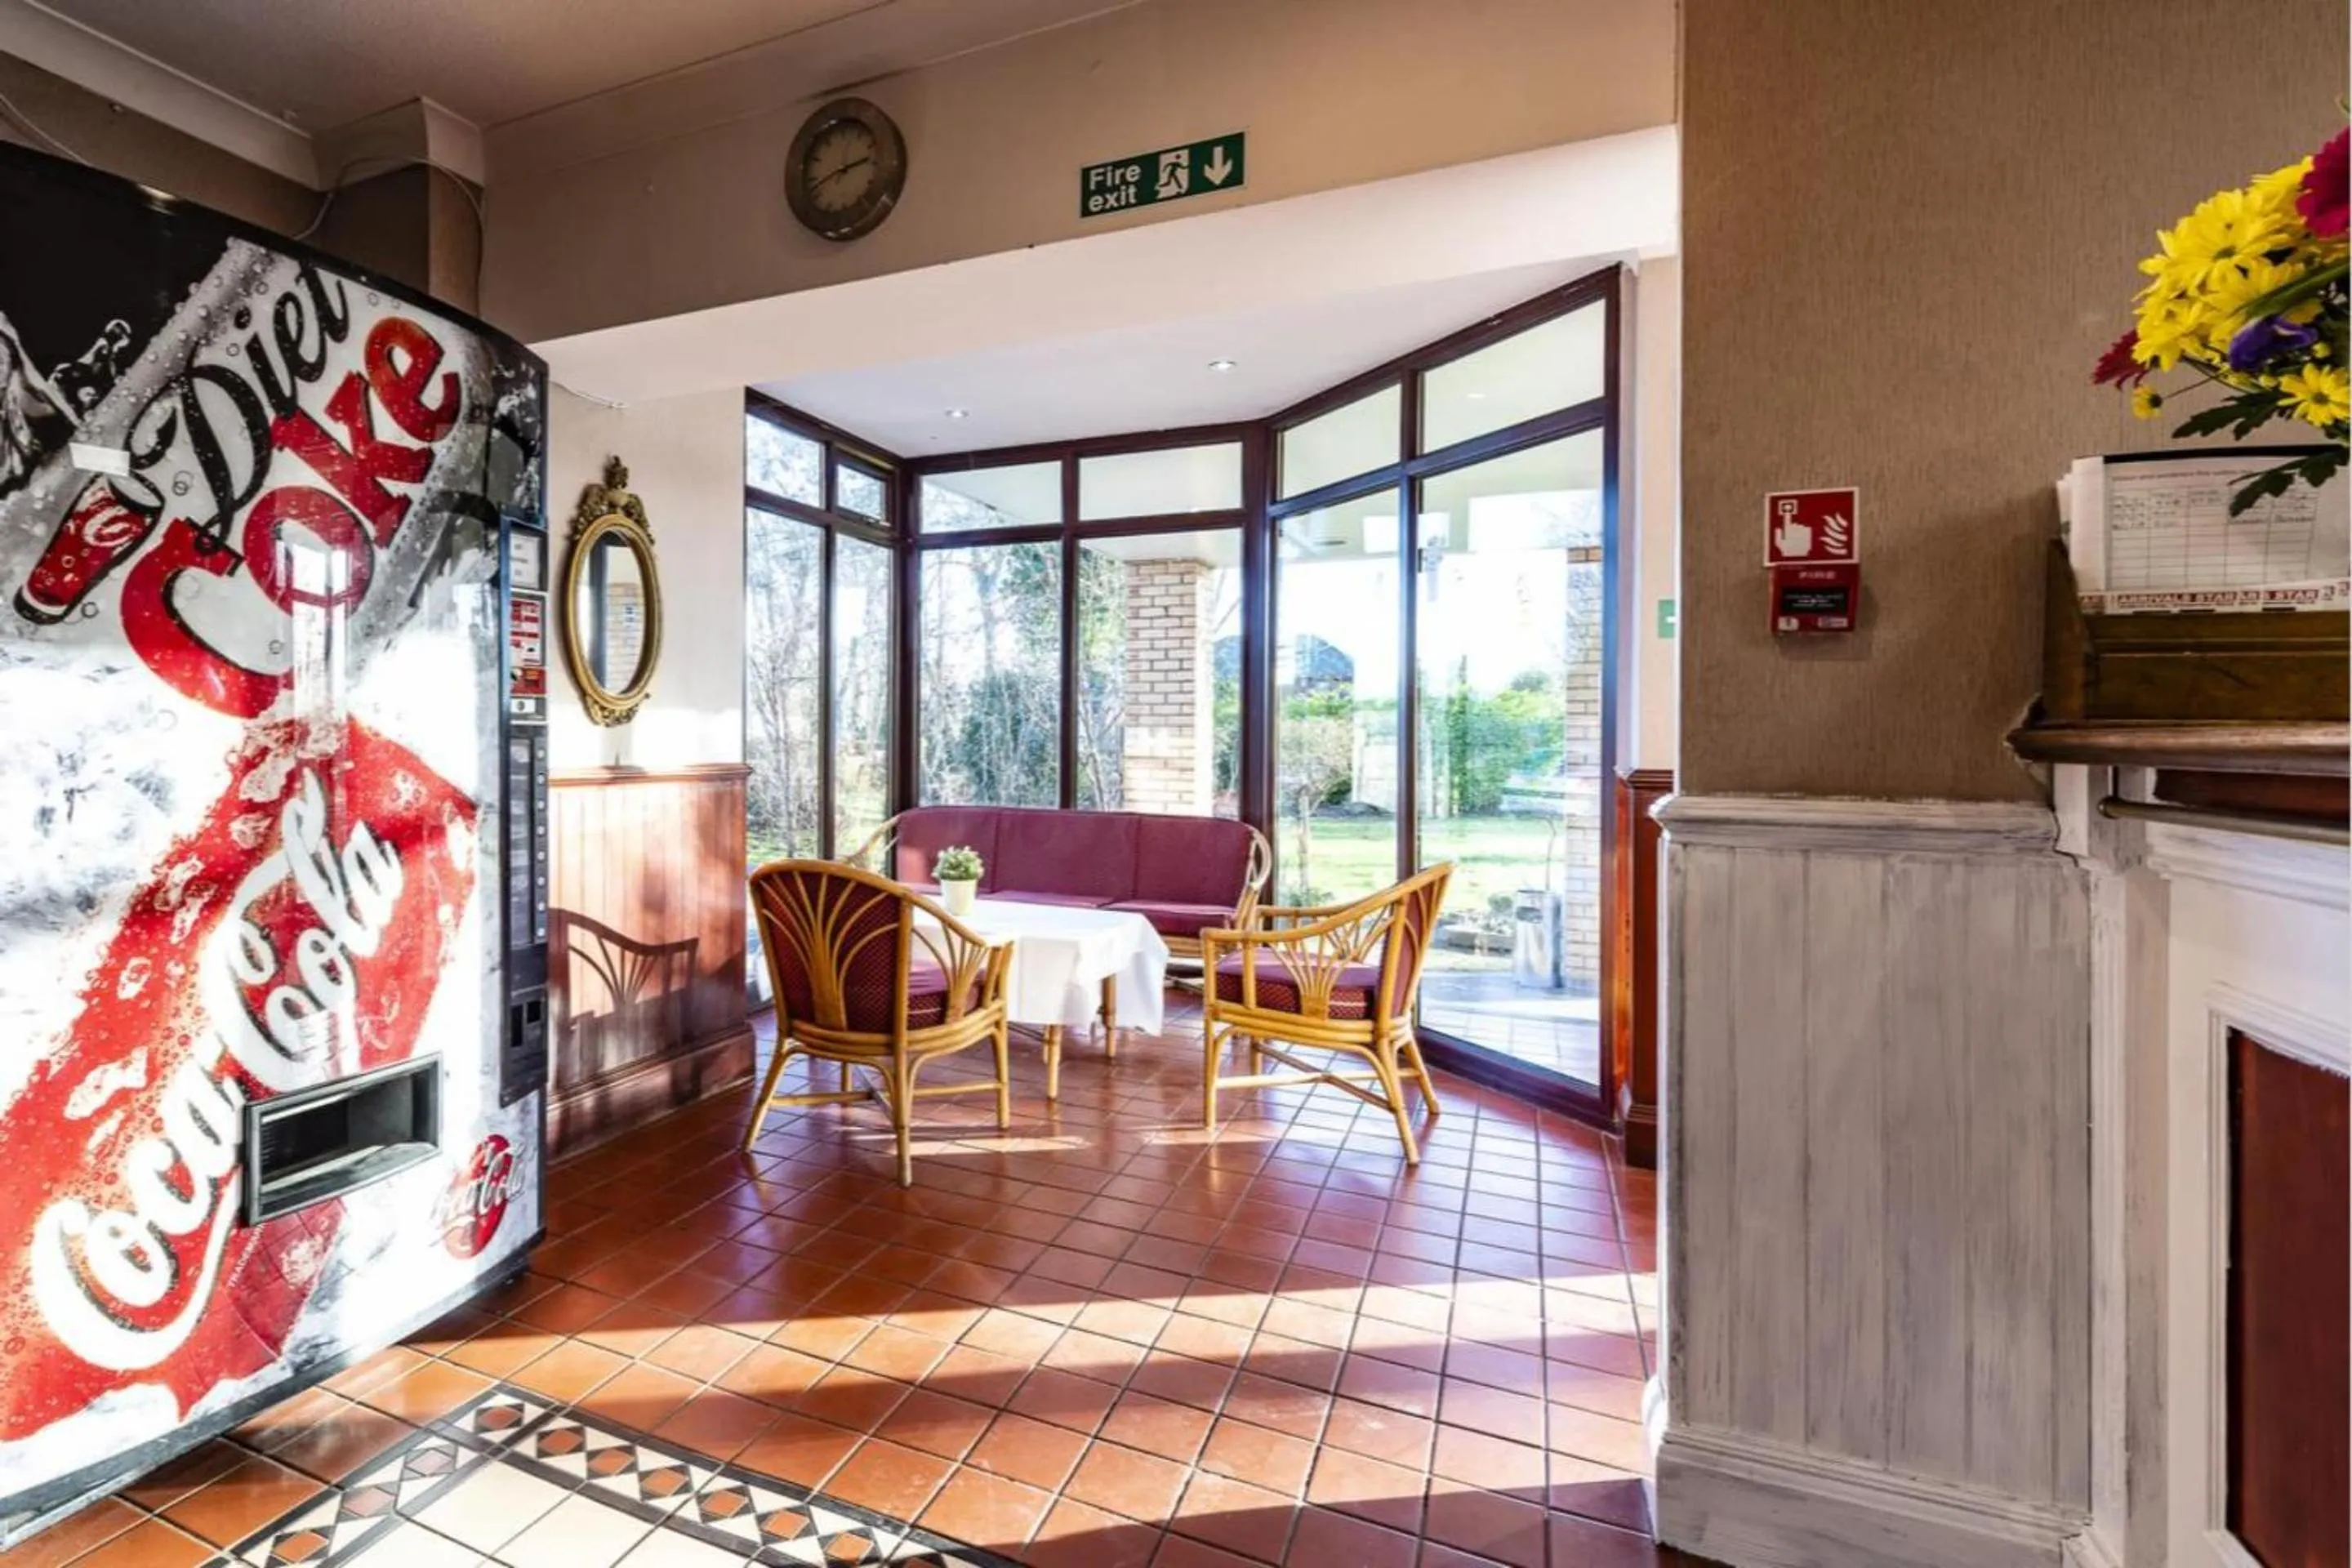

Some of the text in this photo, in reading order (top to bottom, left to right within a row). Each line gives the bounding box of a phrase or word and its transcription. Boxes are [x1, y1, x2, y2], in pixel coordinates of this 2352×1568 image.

[1089, 164, 1142, 190] Fire
[1089, 185, 1138, 212] exit
[123, 261, 350, 552] Diet
[120, 315, 462, 719] Coke
